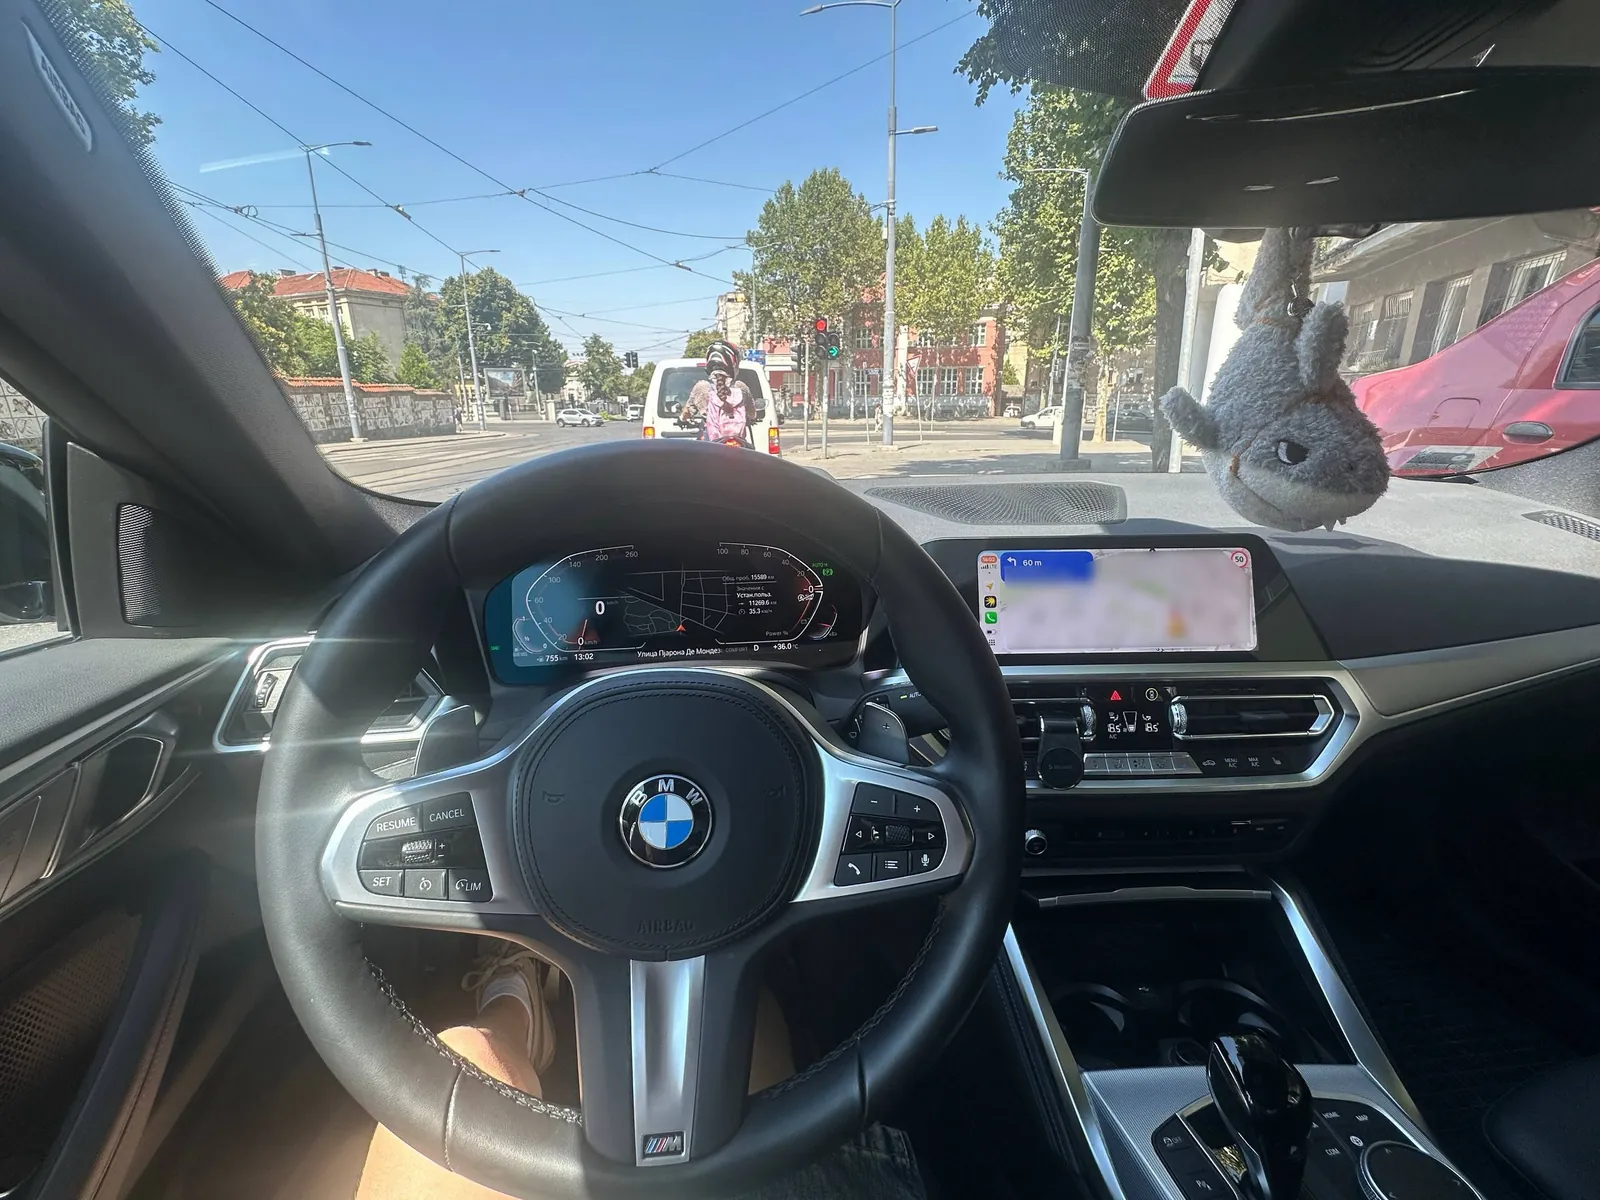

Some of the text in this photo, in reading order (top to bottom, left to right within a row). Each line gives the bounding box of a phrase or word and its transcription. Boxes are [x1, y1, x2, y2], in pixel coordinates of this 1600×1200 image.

[1235, 555, 1244, 563] 50
[548, 576, 561, 584] 100
[808, 585, 814, 593] 0
[595, 600, 606, 615] 0
[577, 637, 585, 646] 0
[574, 653, 594, 661] 13:02
[637, 650, 658, 658] Улица
[686, 648, 695, 656] Де
[545, 654, 559, 662] 755
[629, 778, 703, 808] BMW
[429, 808, 465, 822] CANCEL
[376, 816, 417, 833] RESUME
[372, 876, 392, 887] SET
[465, 881, 482, 892] LIM
[1322, 1111, 1340, 1119] HOME
[1325, 1147, 1341, 1156] COM
